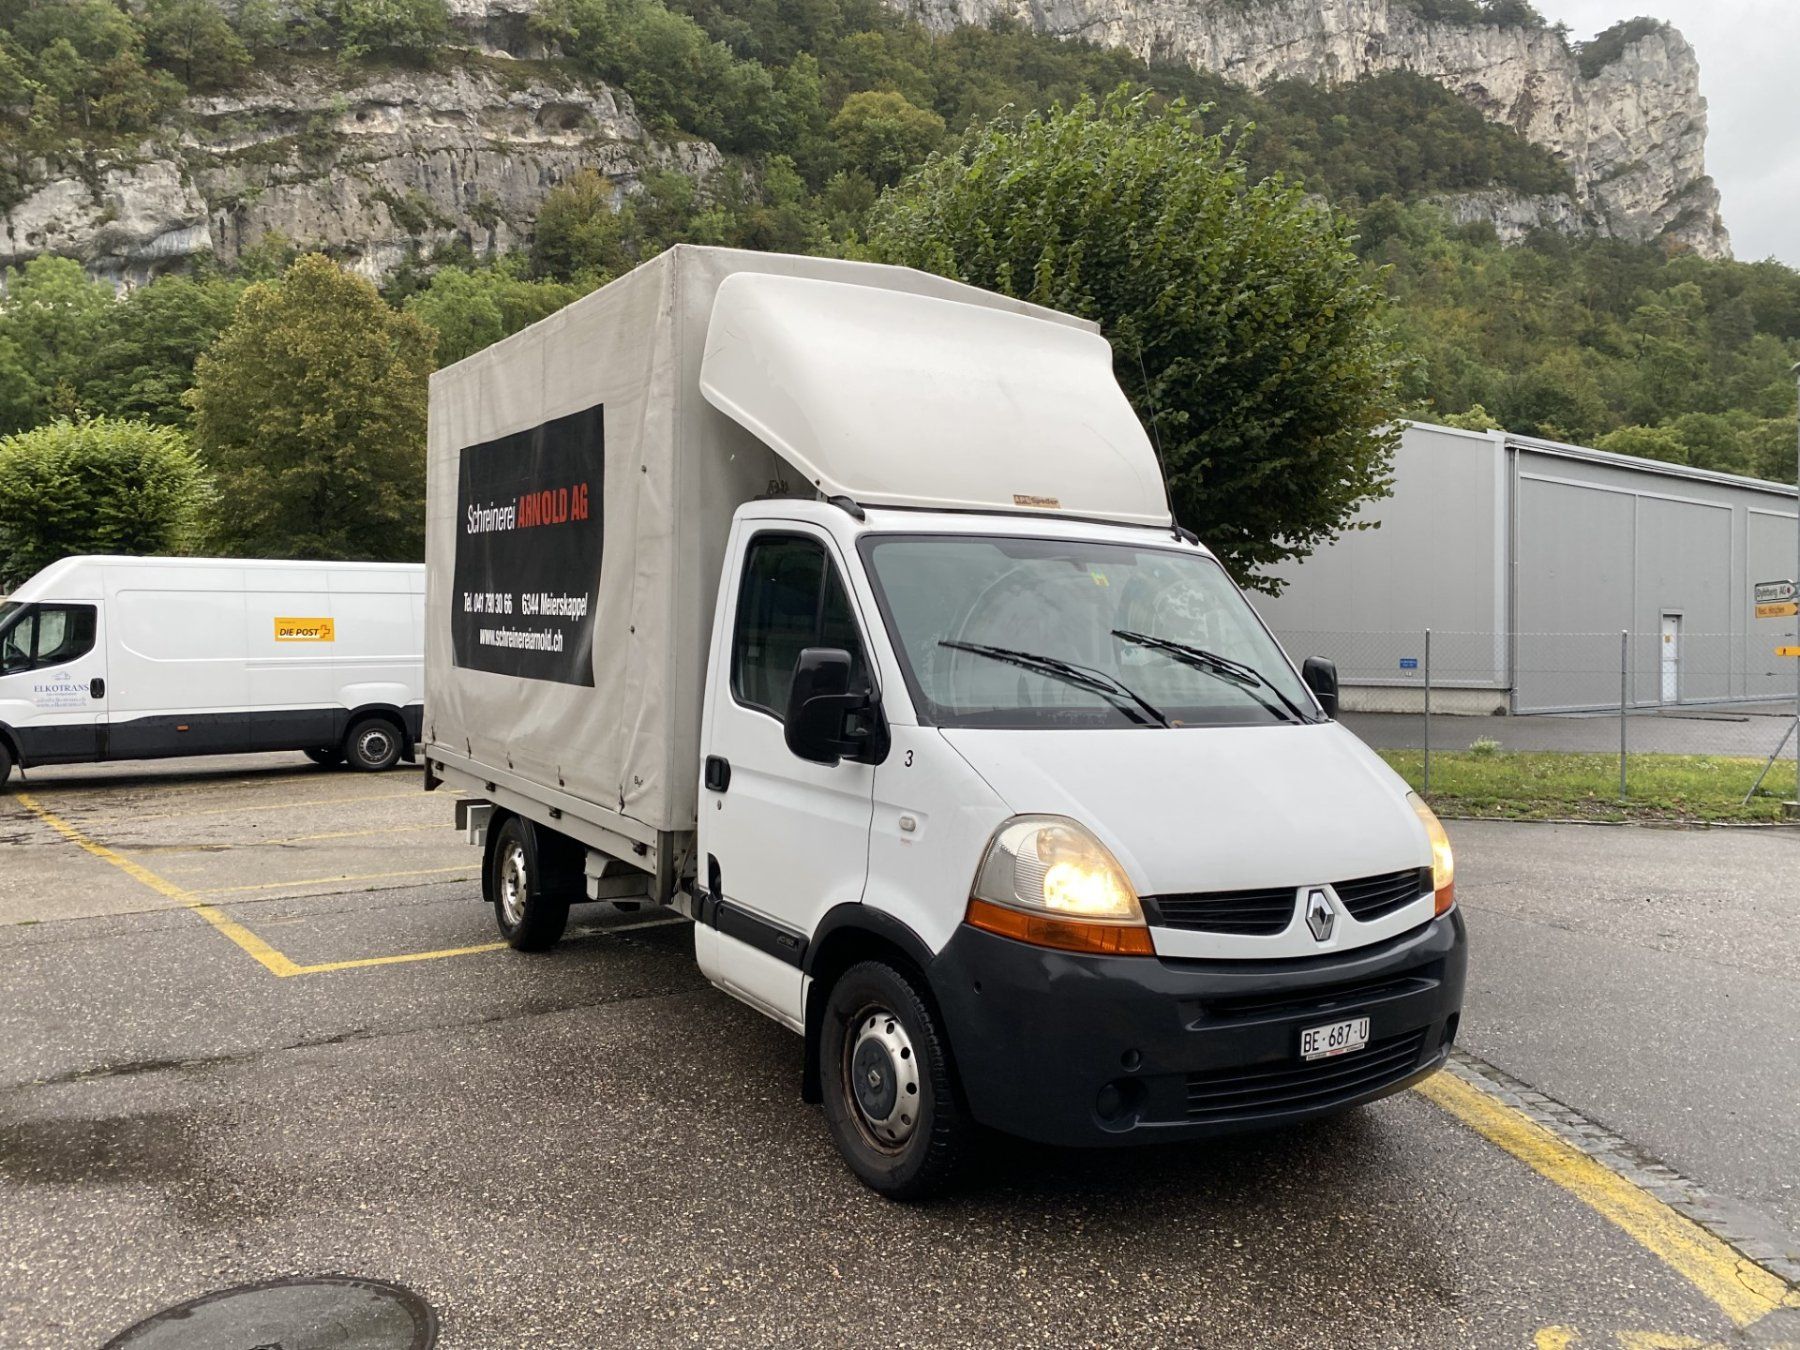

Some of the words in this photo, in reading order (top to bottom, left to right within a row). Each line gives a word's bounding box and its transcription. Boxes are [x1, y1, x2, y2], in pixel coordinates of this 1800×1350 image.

[467, 498, 516, 534] Schreinerei
[517, 488, 568, 528] ARNOLD
[571, 483, 588, 520] AG
[522, 593, 539, 616] 6344
[540, 592, 588, 622] Meierskappel
[279, 628, 294, 636] DIE
[296, 628, 319, 636] POST
[34, 684, 89, 692] ELKOTRANS
[904, 749, 914, 768] 3
[1303, 1030, 1320, 1053] BE
[1328, 1023, 1352, 1047] 687
[1360, 1019, 1368, 1040] U
